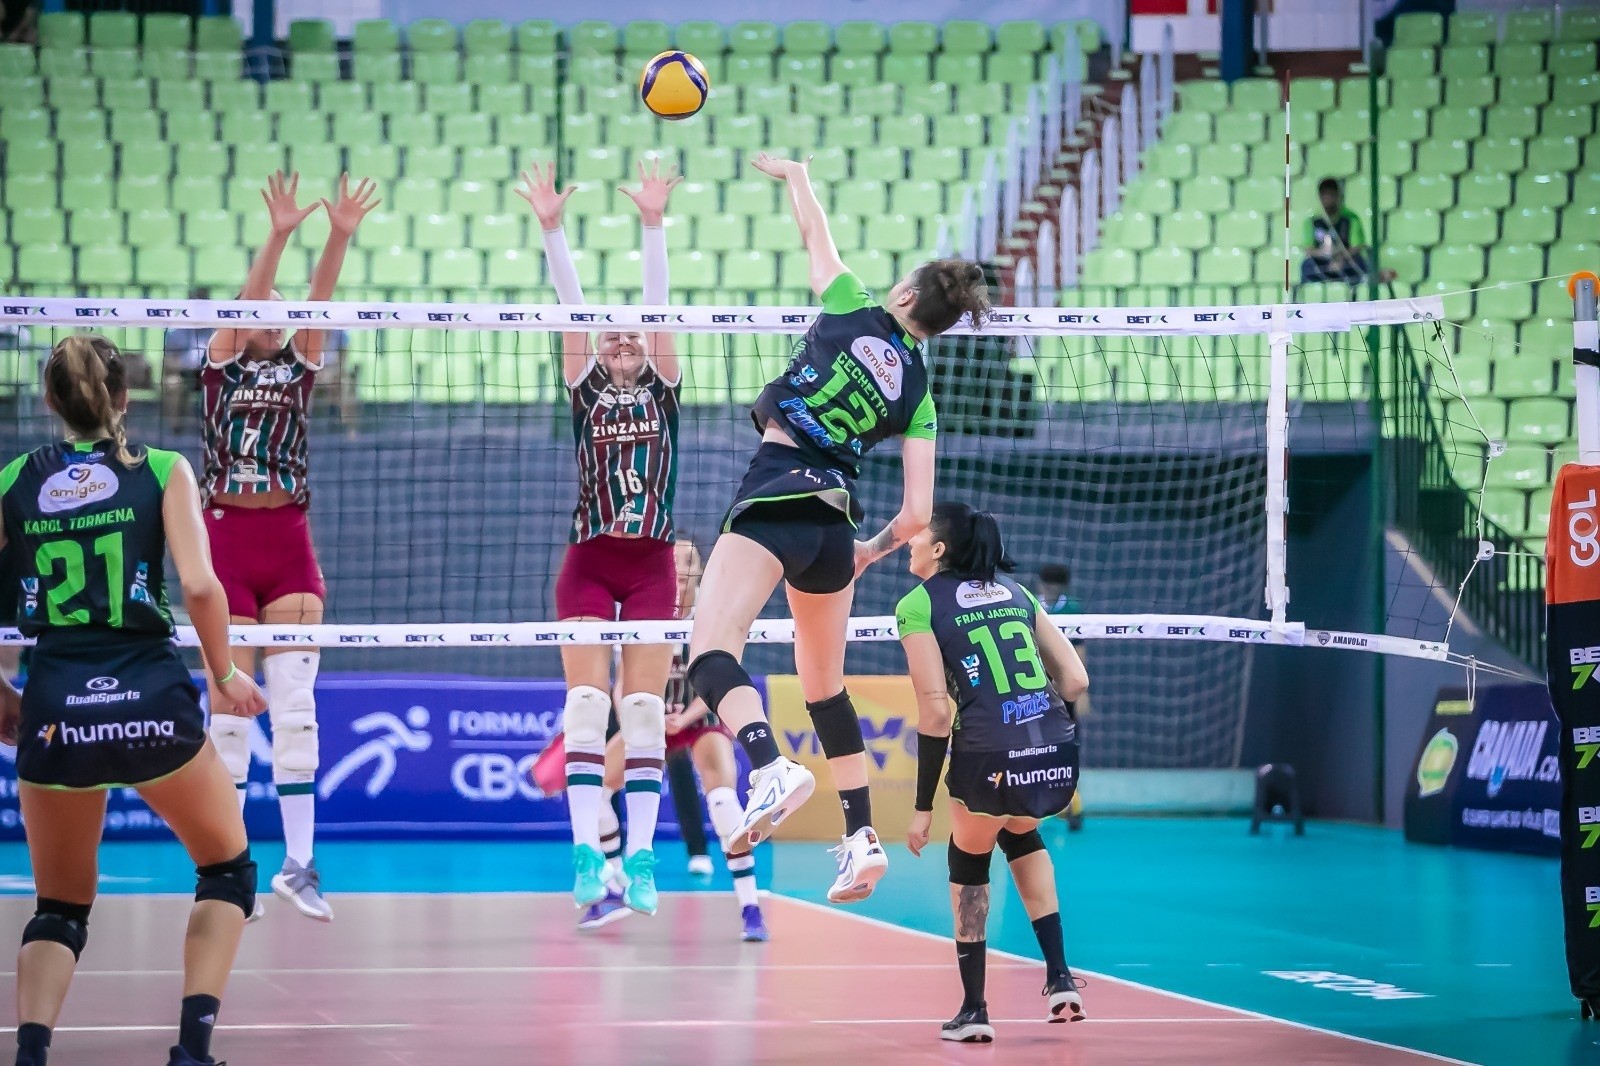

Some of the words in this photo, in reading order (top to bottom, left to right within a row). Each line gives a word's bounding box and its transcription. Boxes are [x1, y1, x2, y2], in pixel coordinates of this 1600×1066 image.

[782, 314, 817, 323] BET7
[837, 351, 889, 417] CECHETTO
[803, 361, 878, 444] 12
[241, 427, 260, 456] 7
[592, 420, 660, 438] ZINZANE
[50, 481, 107, 498] amigão
[615, 468, 644, 496] 16
[24, 519, 64, 534] KAROL
[69, 508, 136, 529] TORMENA
[1568, 489, 1600, 567] GOL
[35, 531, 124, 628] 21
[955, 611, 985, 626] FRAN
[987, 607, 1029, 619] JACINTHO
[664, 631, 689, 640] BET
[1057, 625, 1082, 635] T7K
[967, 620, 1048, 695] 13
[1569, 648, 1600, 665] BE
[1571, 664, 1600, 691] 7
[1002, 691, 1050, 724] Prats
[61, 720, 175, 745] humana
[747, 728, 767, 743] 23
[1573, 726, 1600, 744] BE
[1008, 745, 1058, 759] QualiSports
[1574, 744, 1600, 769] 7
[1006, 766, 1073, 787] humana
